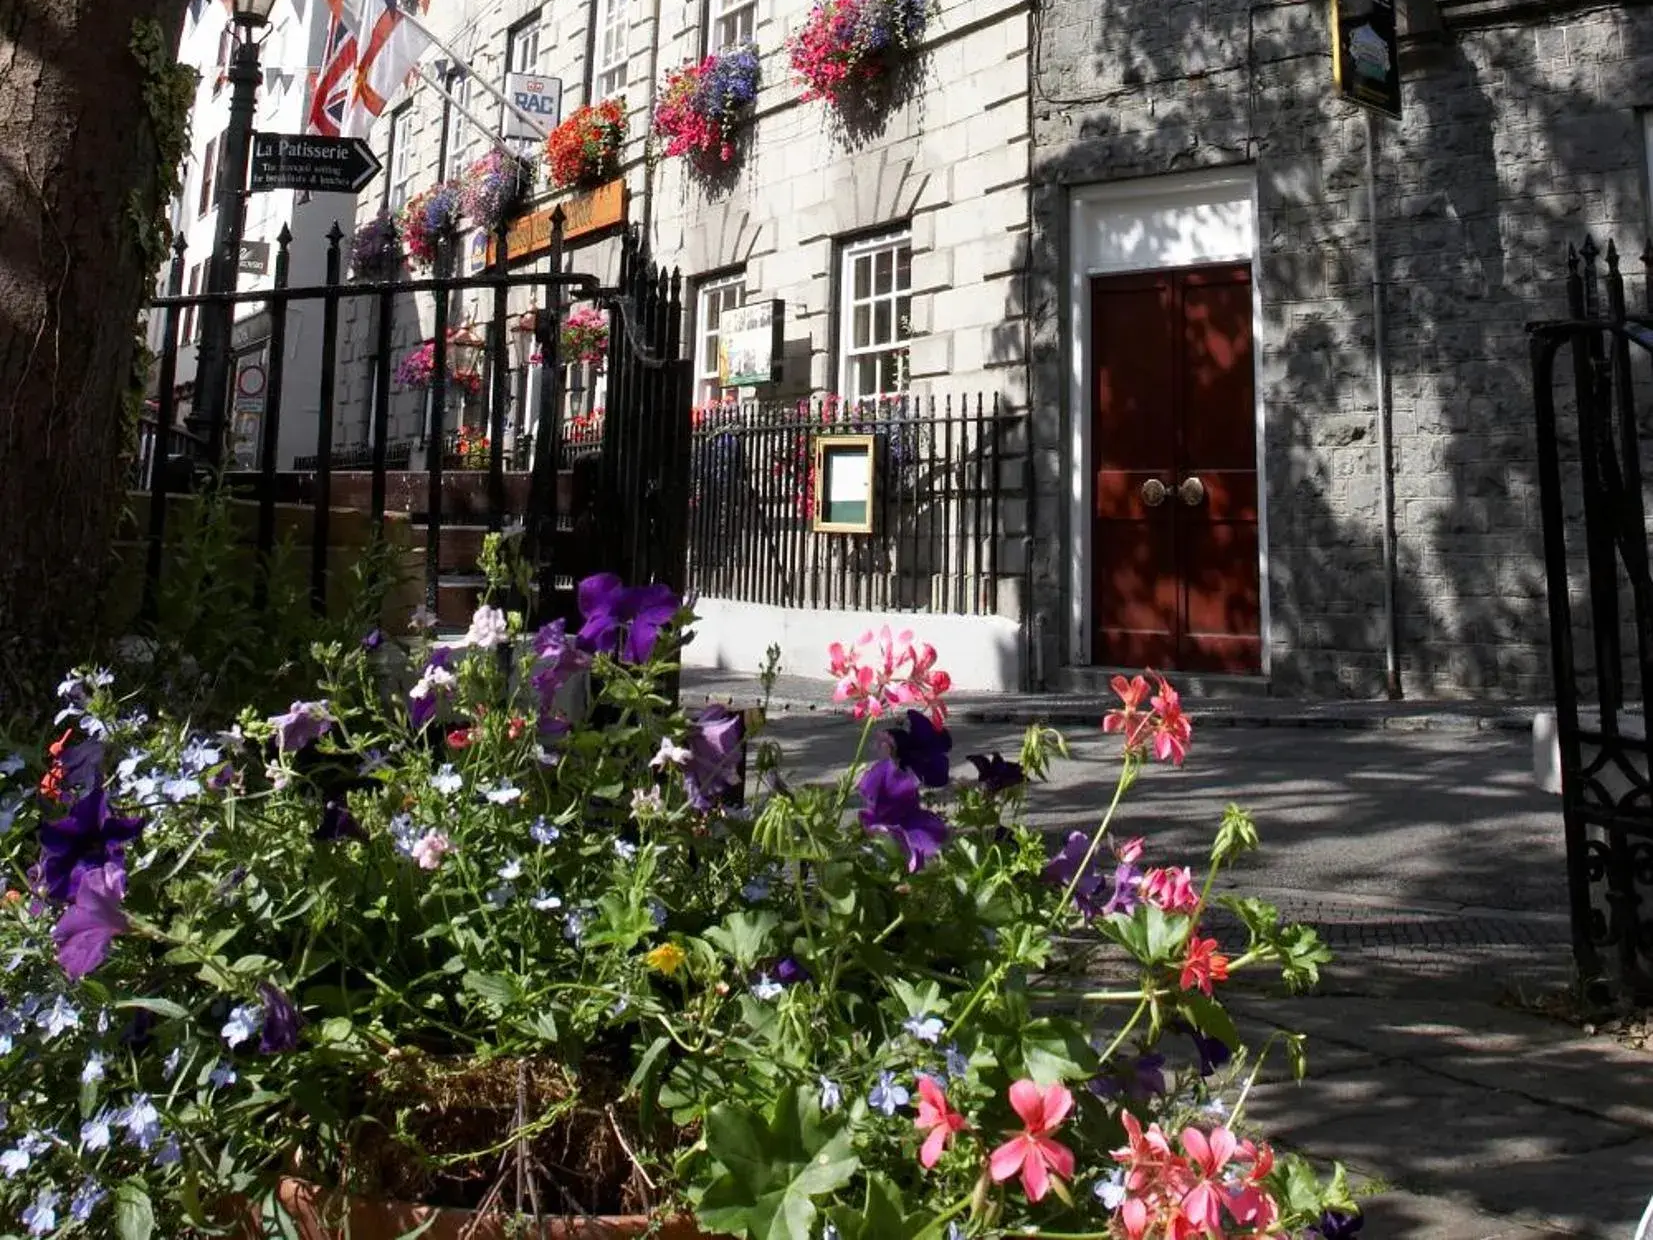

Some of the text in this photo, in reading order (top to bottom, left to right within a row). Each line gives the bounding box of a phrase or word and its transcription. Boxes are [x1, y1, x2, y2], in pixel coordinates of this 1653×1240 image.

[514, 92, 554, 115] RAC
[256, 140, 350, 160] La Patisserie
